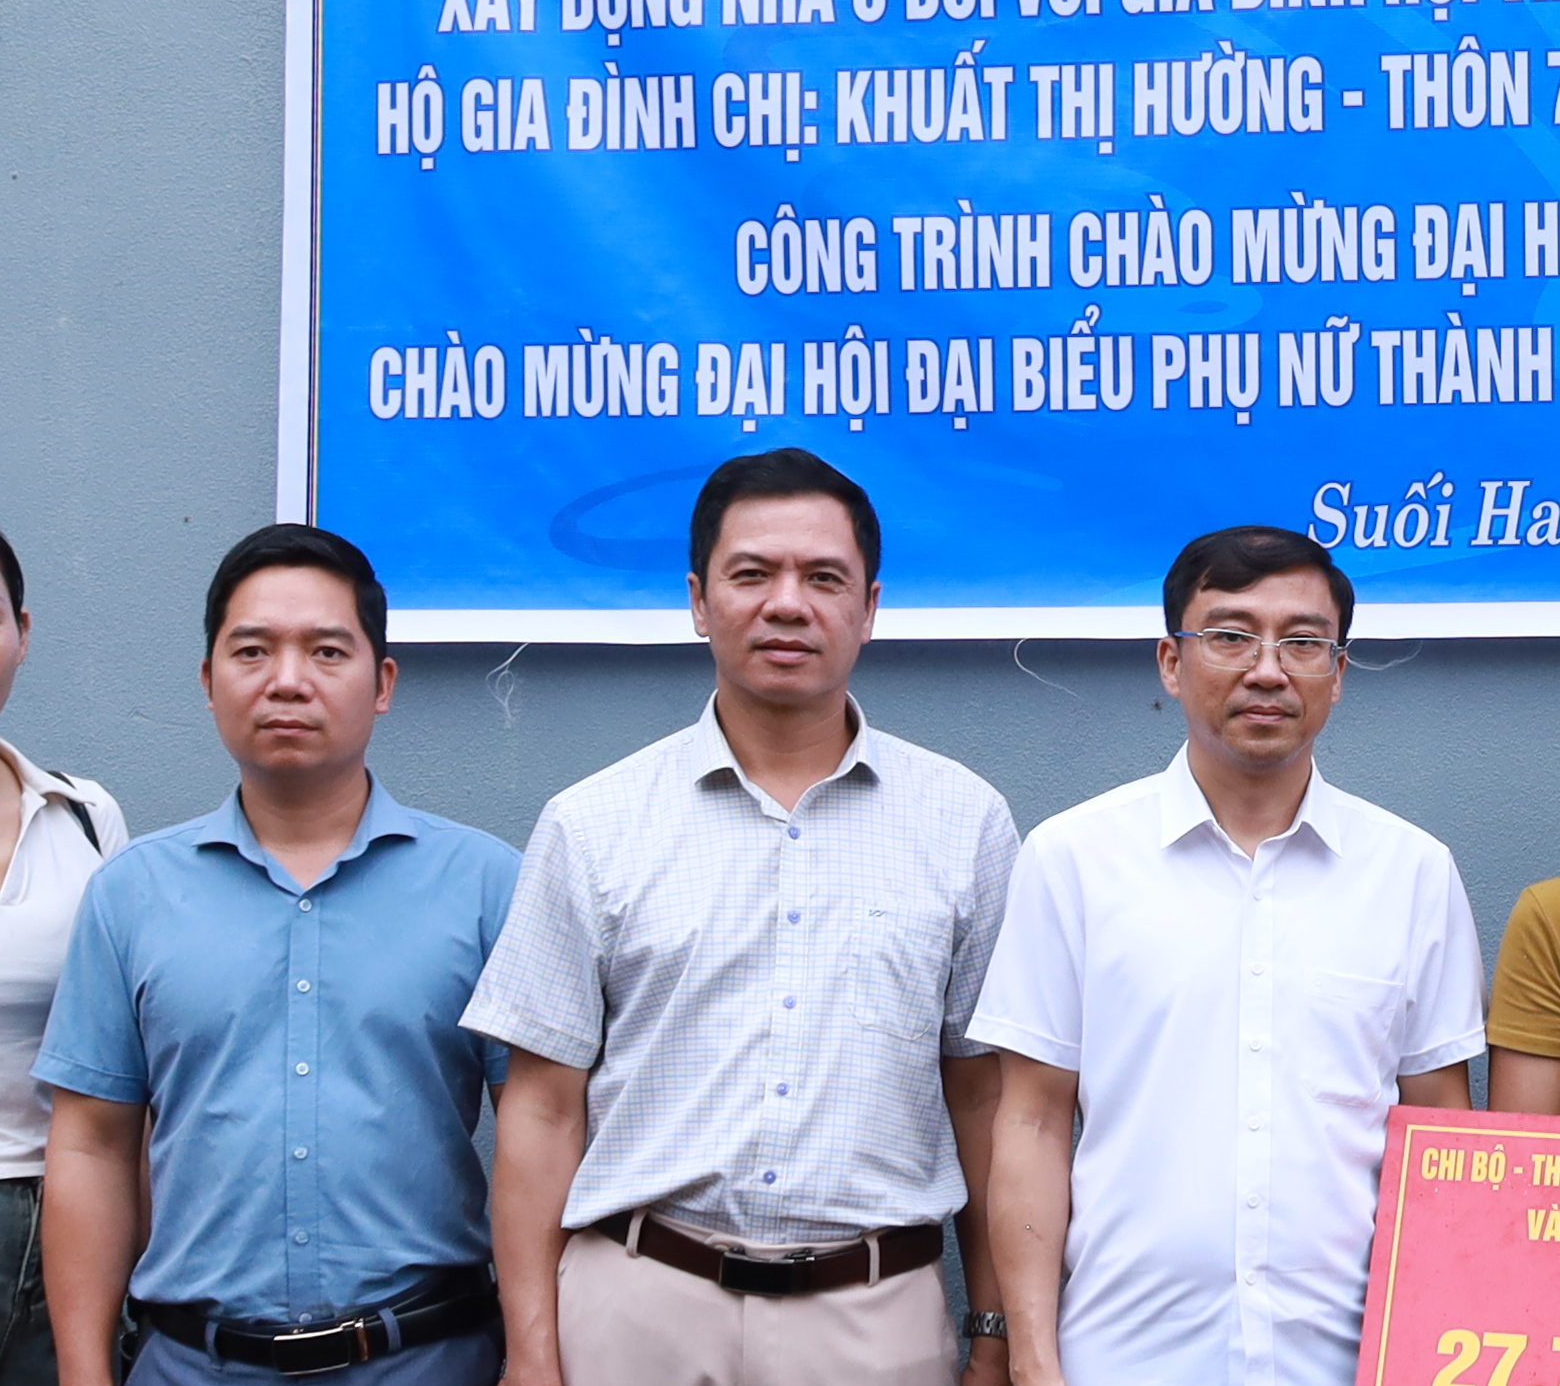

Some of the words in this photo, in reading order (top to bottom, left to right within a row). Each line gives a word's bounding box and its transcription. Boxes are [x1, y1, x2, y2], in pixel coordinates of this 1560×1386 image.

[376, 64, 443, 170] HỘ
[461, 77, 549, 152] GIA
[566, 61, 696, 151] ĐÌNH
[712, 69, 819, 162] CHỊ:
[838, 40, 1014, 147] KHUẤT
[1029, 63, 1115, 154] THỊ
[1134, 40, 1324, 135] HƯỜNG
[1342, 88, 1365, 107] -
[1381, 35, 1529, 130] THÔN
[737, 203, 877, 295] CÔNG
[893, 199, 1052, 291] TRÌNH
[1068, 194, 1213, 286] CHÀO
[1231, 191, 1396, 284] MỪNG
[1412, 202, 1505, 296] ĐẠI
[368, 331, 506, 419] CHÀO
[523, 327, 679, 418] MỪNG
[696, 341, 786, 432] ĐẠI
[804, 324, 890, 431] HỘI
[906, 337, 994, 430] ĐẠI
[1012, 304, 1134, 412] BIỂU
[1152, 331, 1260, 424] PHỤ
[1278, 316, 1360, 407] NỮ
[1371, 312, 1552, 405] THÀNH
[1306, 471, 1454, 549] Suối
[1421, 1147, 1463, 1181] CHI
[1471, 1143, 1506, 1190] BỘ
